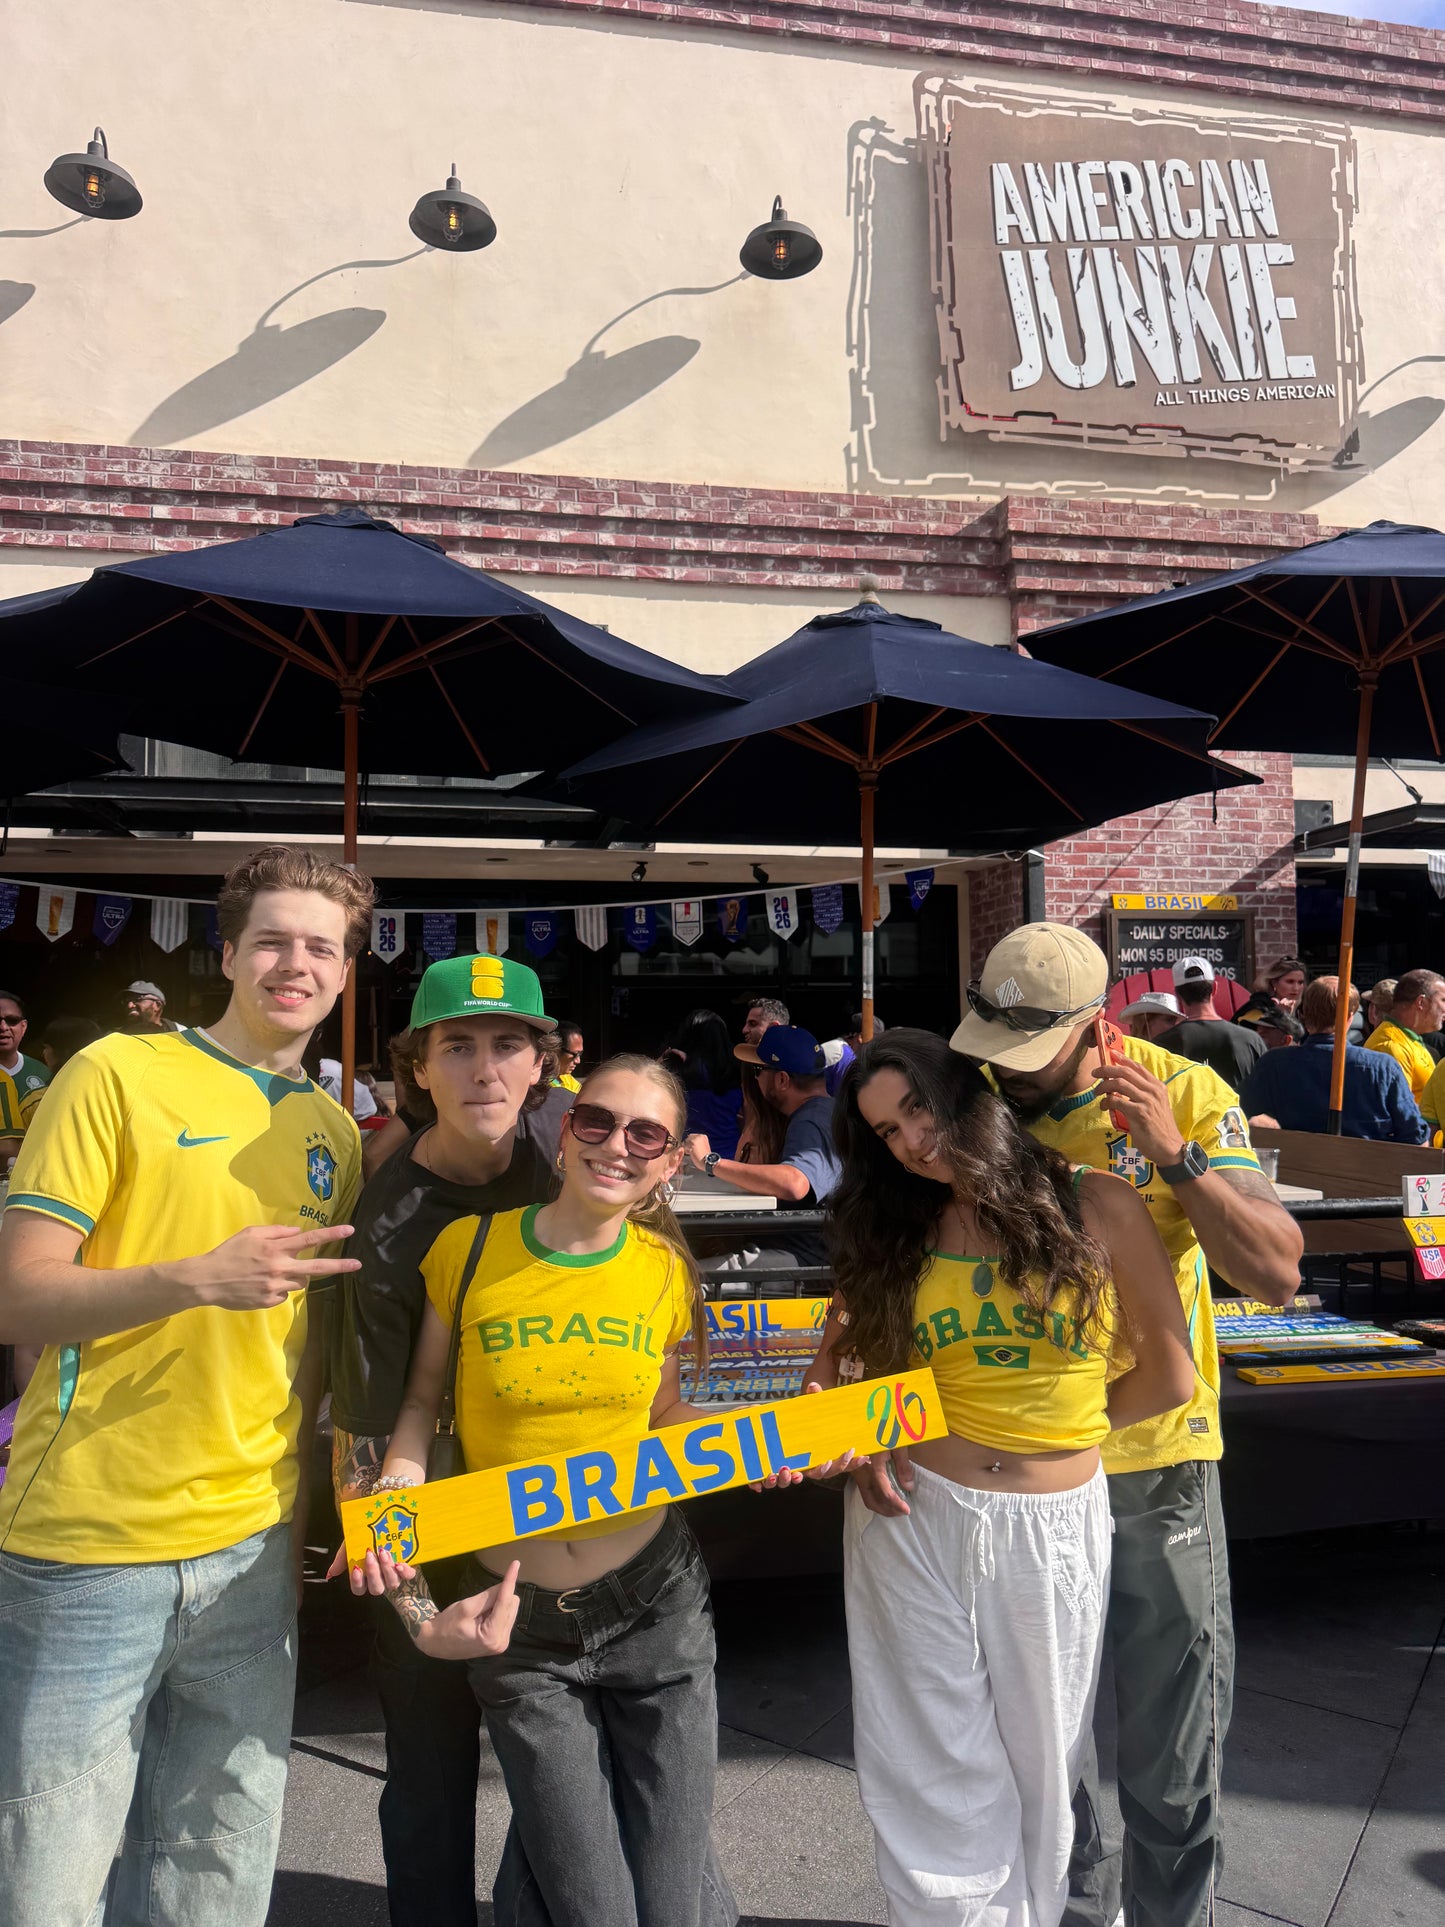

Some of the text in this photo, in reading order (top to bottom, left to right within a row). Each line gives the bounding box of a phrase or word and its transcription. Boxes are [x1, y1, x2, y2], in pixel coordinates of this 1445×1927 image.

[990, 158, 1279, 245] AMERICAN
[1000, 243, 1316, 392] JUNKIE
[1155, 384, 1336, 406] ALL THINGS AMERICAN
[773, 896, 789, 913] 20
[1144, 896, 1208, 910] BRASIL
[379, 917, 396, 934] 20
[775, 913, 791, 929] 26
[379, 935, 396, 952] 26
[1149, 948, 1164, 962] $5
[1121, 1156, 1140, 1166] CBF
[1421, 1249, 1440, 1261] USA
[704, 1303, 782, 1333] ASIL
[477, 1312, 657, 1359] BRASIL
[913, 1302, 1089, 1362] BRASIL
[709, 1358, 814, 1369] RAMS
[506, 1411, 812, 1536] BRASIL
[386, 1531, 403, 1541] CBF
